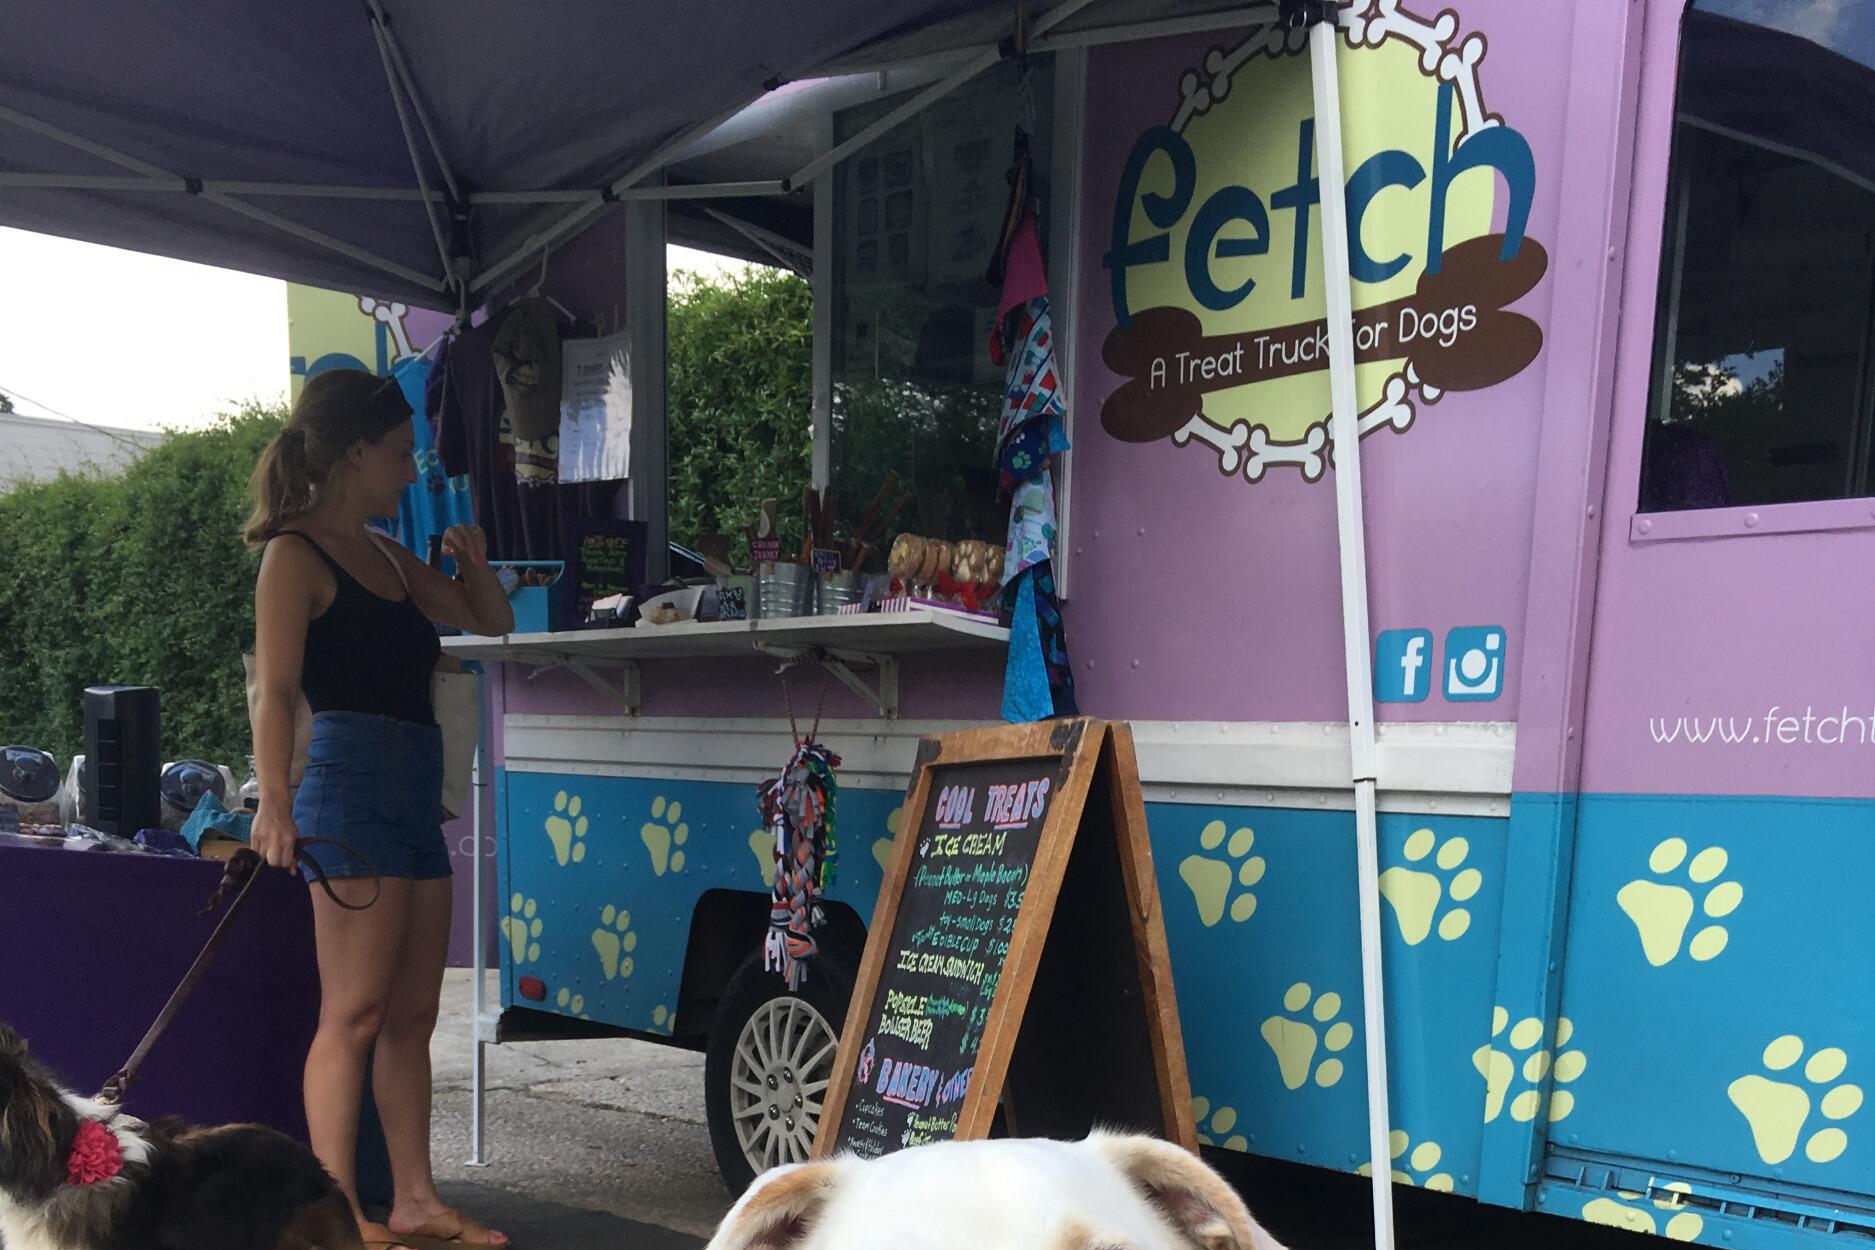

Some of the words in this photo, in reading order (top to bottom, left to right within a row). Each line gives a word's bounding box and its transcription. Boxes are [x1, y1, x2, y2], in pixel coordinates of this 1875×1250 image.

[1102, 83, 1536, 331] fetch
[1149, 357, 1167, 390] A
[1176, 344, 1244, 383] Treat
[1254, 325, 1330, 369] Truck
[1351, 318, 1389, 350] or
[1398, 304, 1477, 347] Dogs
[935, 785, 975, 824] COOL
[984, 777, 1050, 823] TREATS
[930, 834, 961, 858] ICE
[962, 831, 1008, 857] CREAM
[979, 889, 998, 912] Dogs
[897, 950, 919, 973] ICE
[884, 988, 929, 1016] POPSICLE
[876, 1058, 940, 1107] BAKERY
